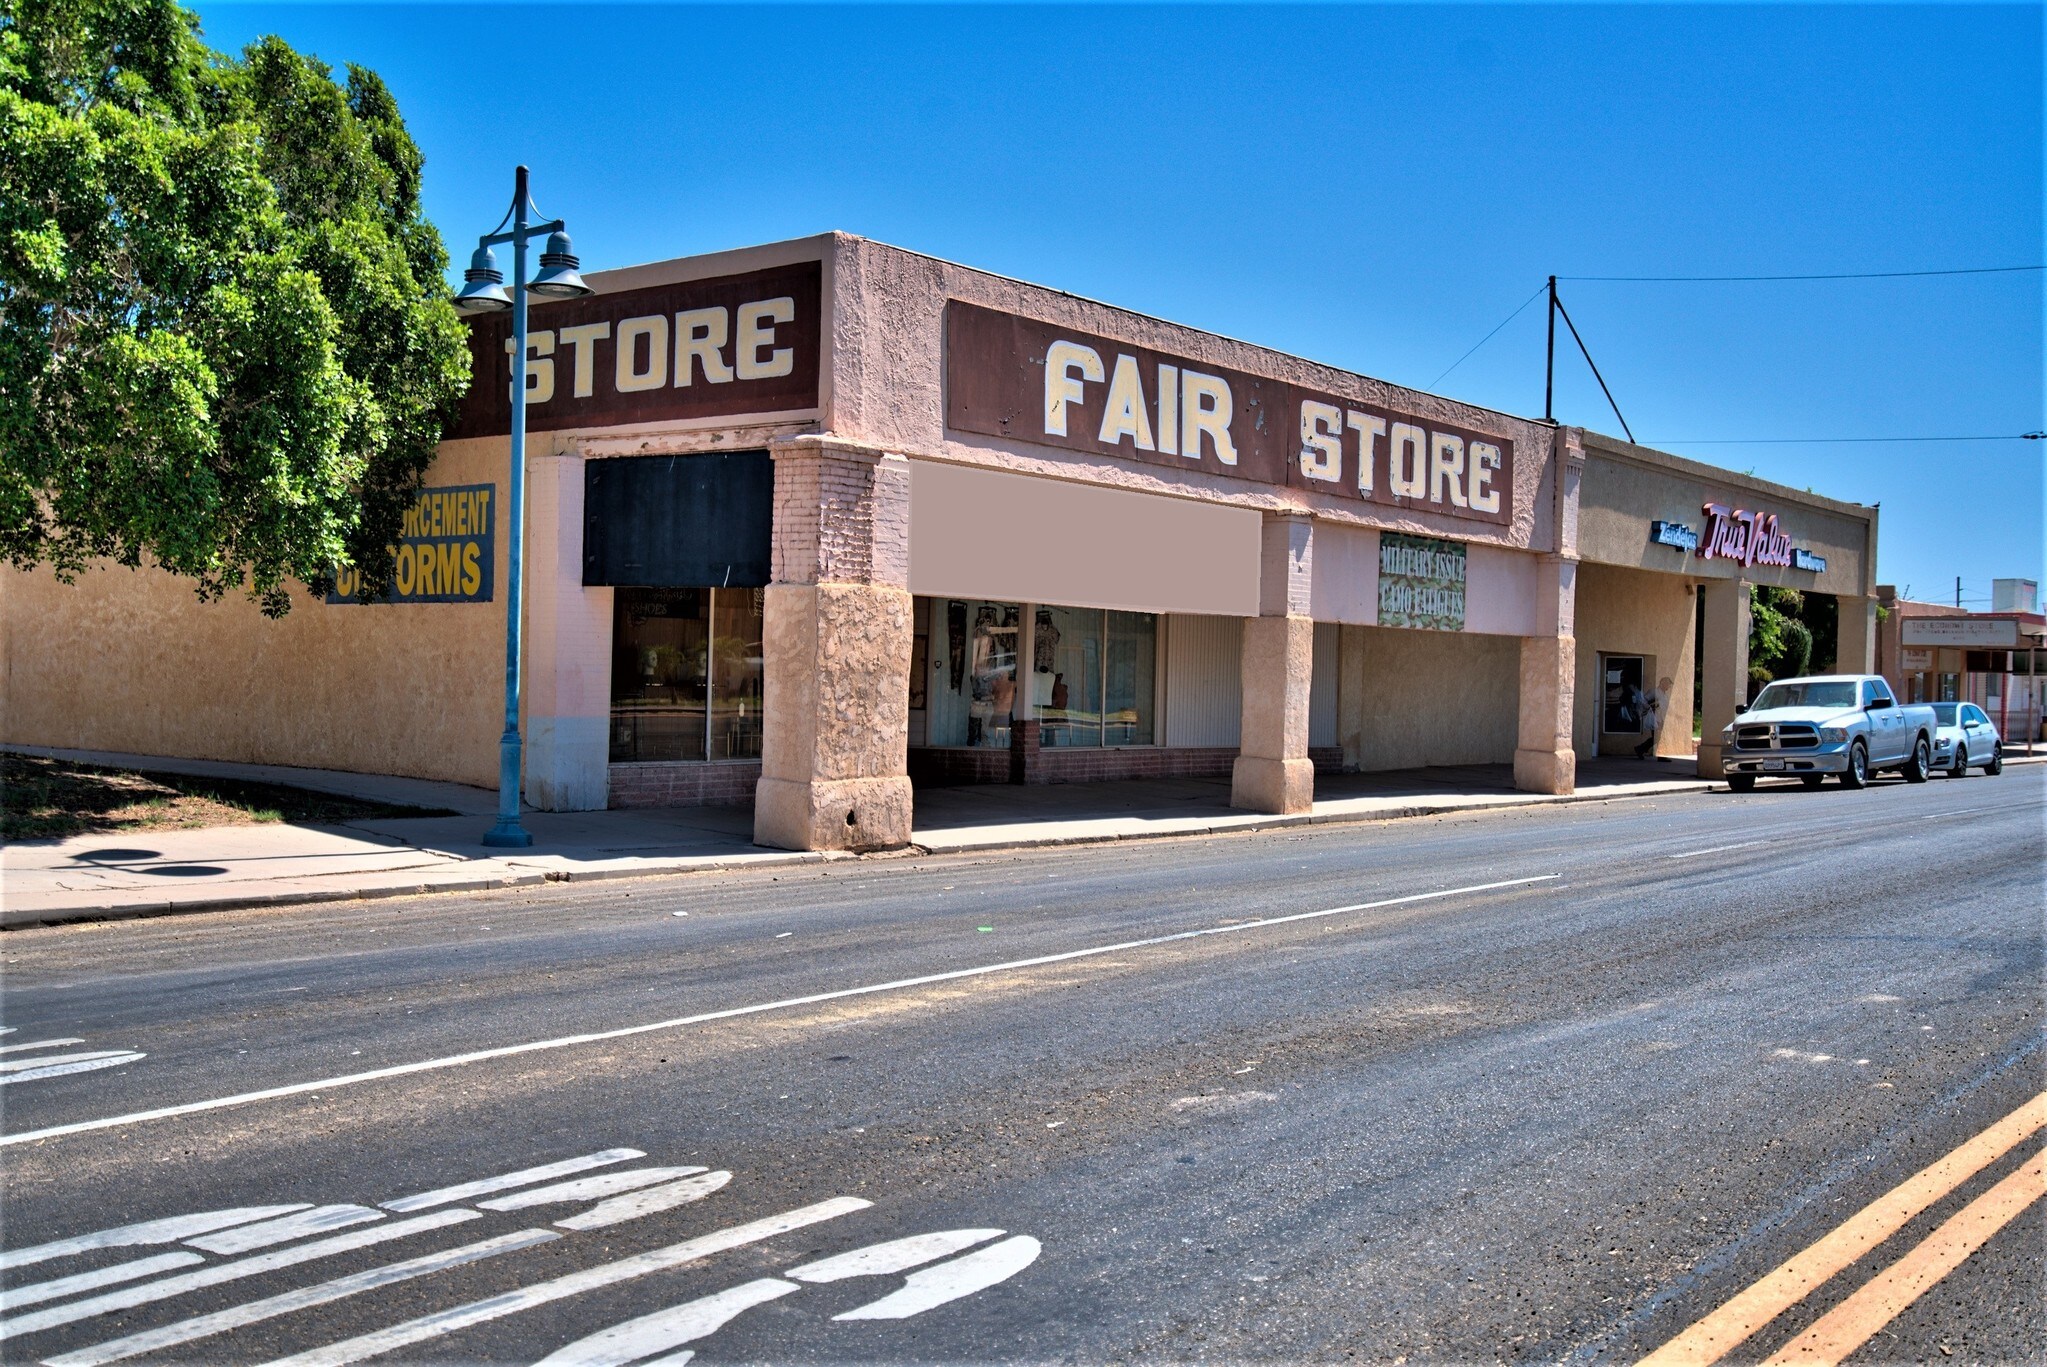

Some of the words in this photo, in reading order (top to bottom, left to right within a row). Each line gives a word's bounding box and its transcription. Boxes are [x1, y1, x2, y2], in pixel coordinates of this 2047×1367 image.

[509, 296, 795, 404] STORE
[1044, 339, 1238, 466] FAIR
[1300, 399, 1501, 514] STORE
[1381, 546, 1434, 578] MILITARY
[1435, 553, 1465, 581] ISSUE
[1658, 522, 1697, 552] Zendejas
[1703, 502, 1745, 560] True
[1736, 511, 1793, 568] Value
[1796, 549, 1827, 573] Hardware
[336, 542, 481, 597] UORMS
[1381, 584, 1412, 613] CAMO
[1414, 588, 1464, 618] FATIGUES
[1911, 621, 1927, 629] THE
